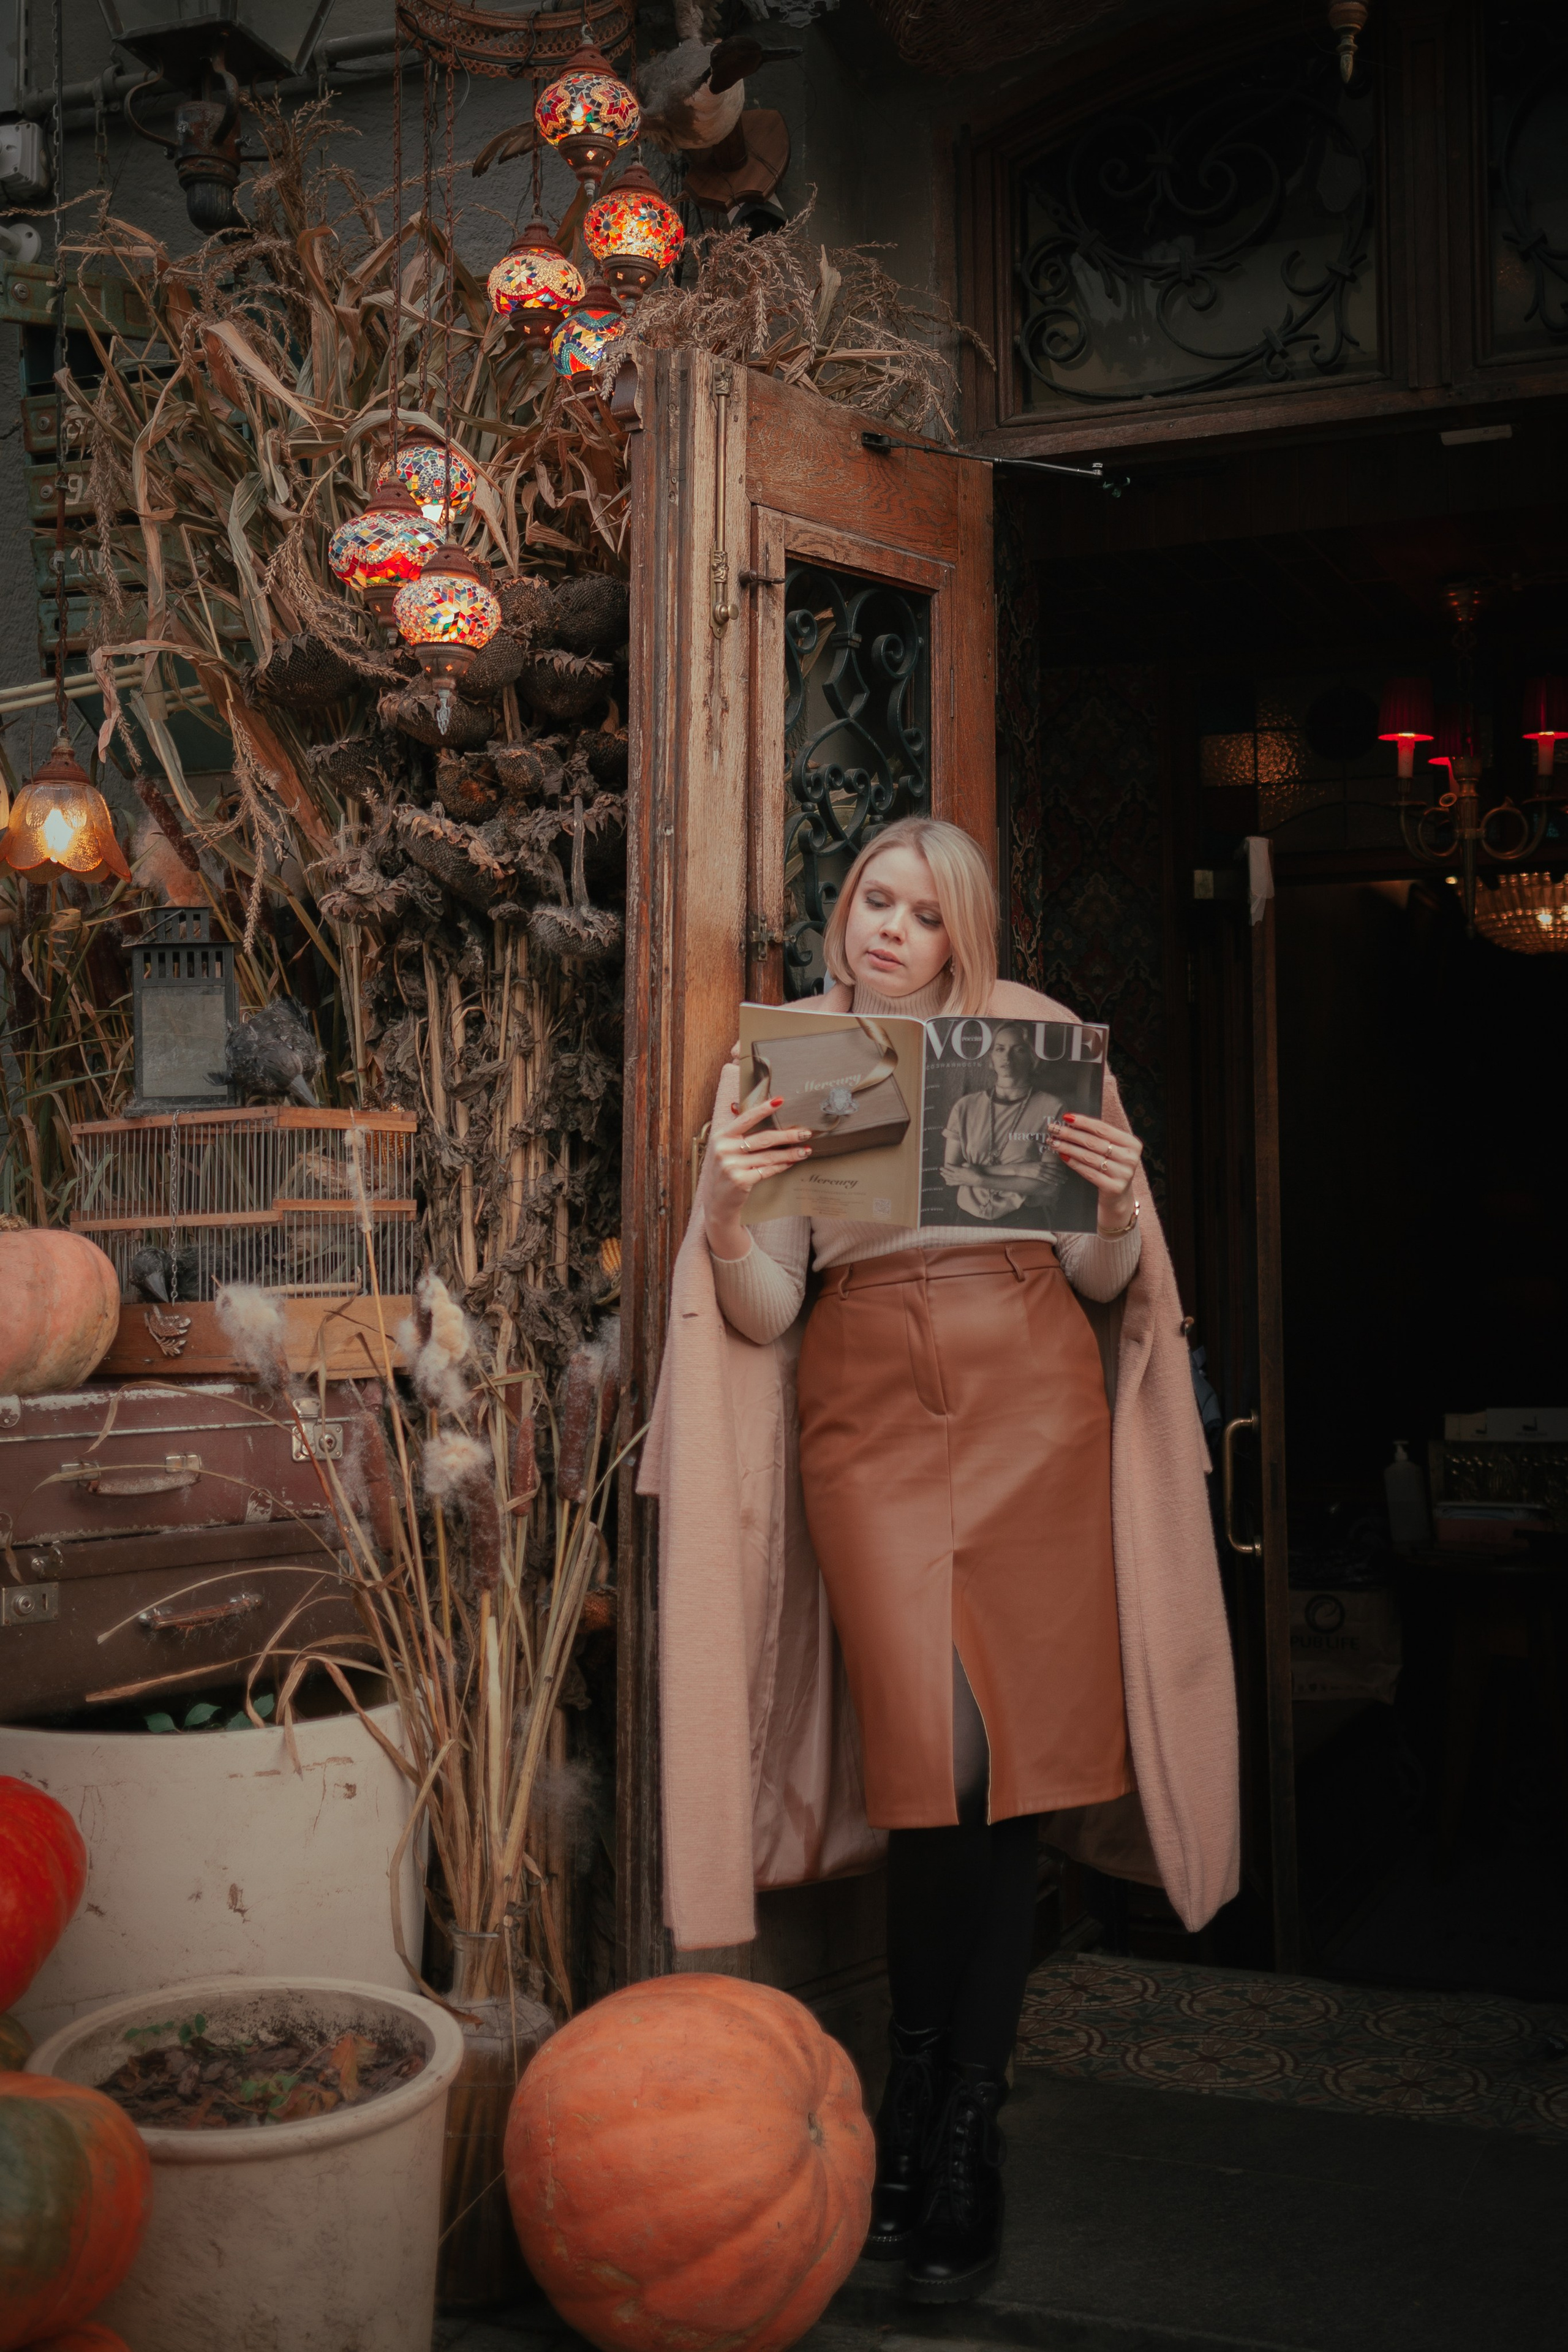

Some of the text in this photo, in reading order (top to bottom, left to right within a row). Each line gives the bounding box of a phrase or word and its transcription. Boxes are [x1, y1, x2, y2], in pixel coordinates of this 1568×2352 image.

[64, 473, 83, 505] 9
[926, 1019, 1103, 1063] VOUE
[796, 1074, 861, 1093] Mercury
[1009, 1133, 1050, 1144] настр
[801, 1174, 859, 1189] Mercury
